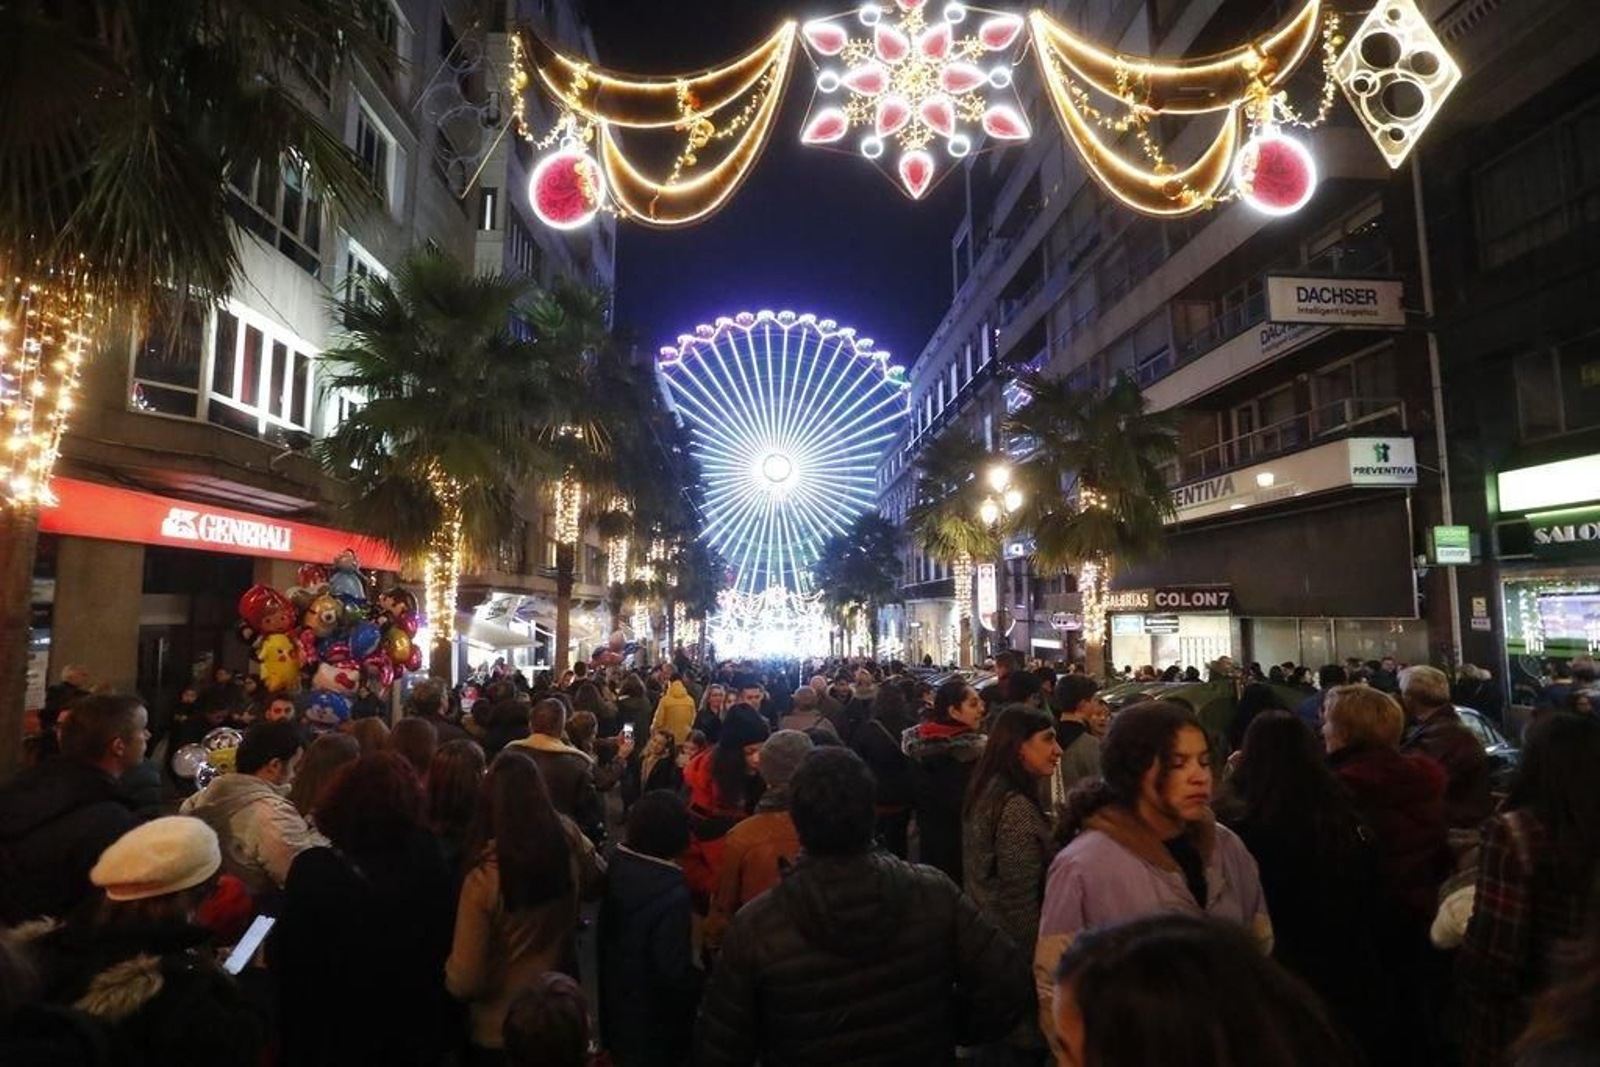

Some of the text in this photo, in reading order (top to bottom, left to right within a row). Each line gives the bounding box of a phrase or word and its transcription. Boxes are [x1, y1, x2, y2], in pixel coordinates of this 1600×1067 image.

[1296, 287, 1378, 305] DACHSER
[1353, 466, 1415, 475] PREVENTIVA
[1174, 475, 1235, 507] ENTIVA
[199, 513, 292, 552] GENERALI
[1534, 522, 1600, 544] SALO
